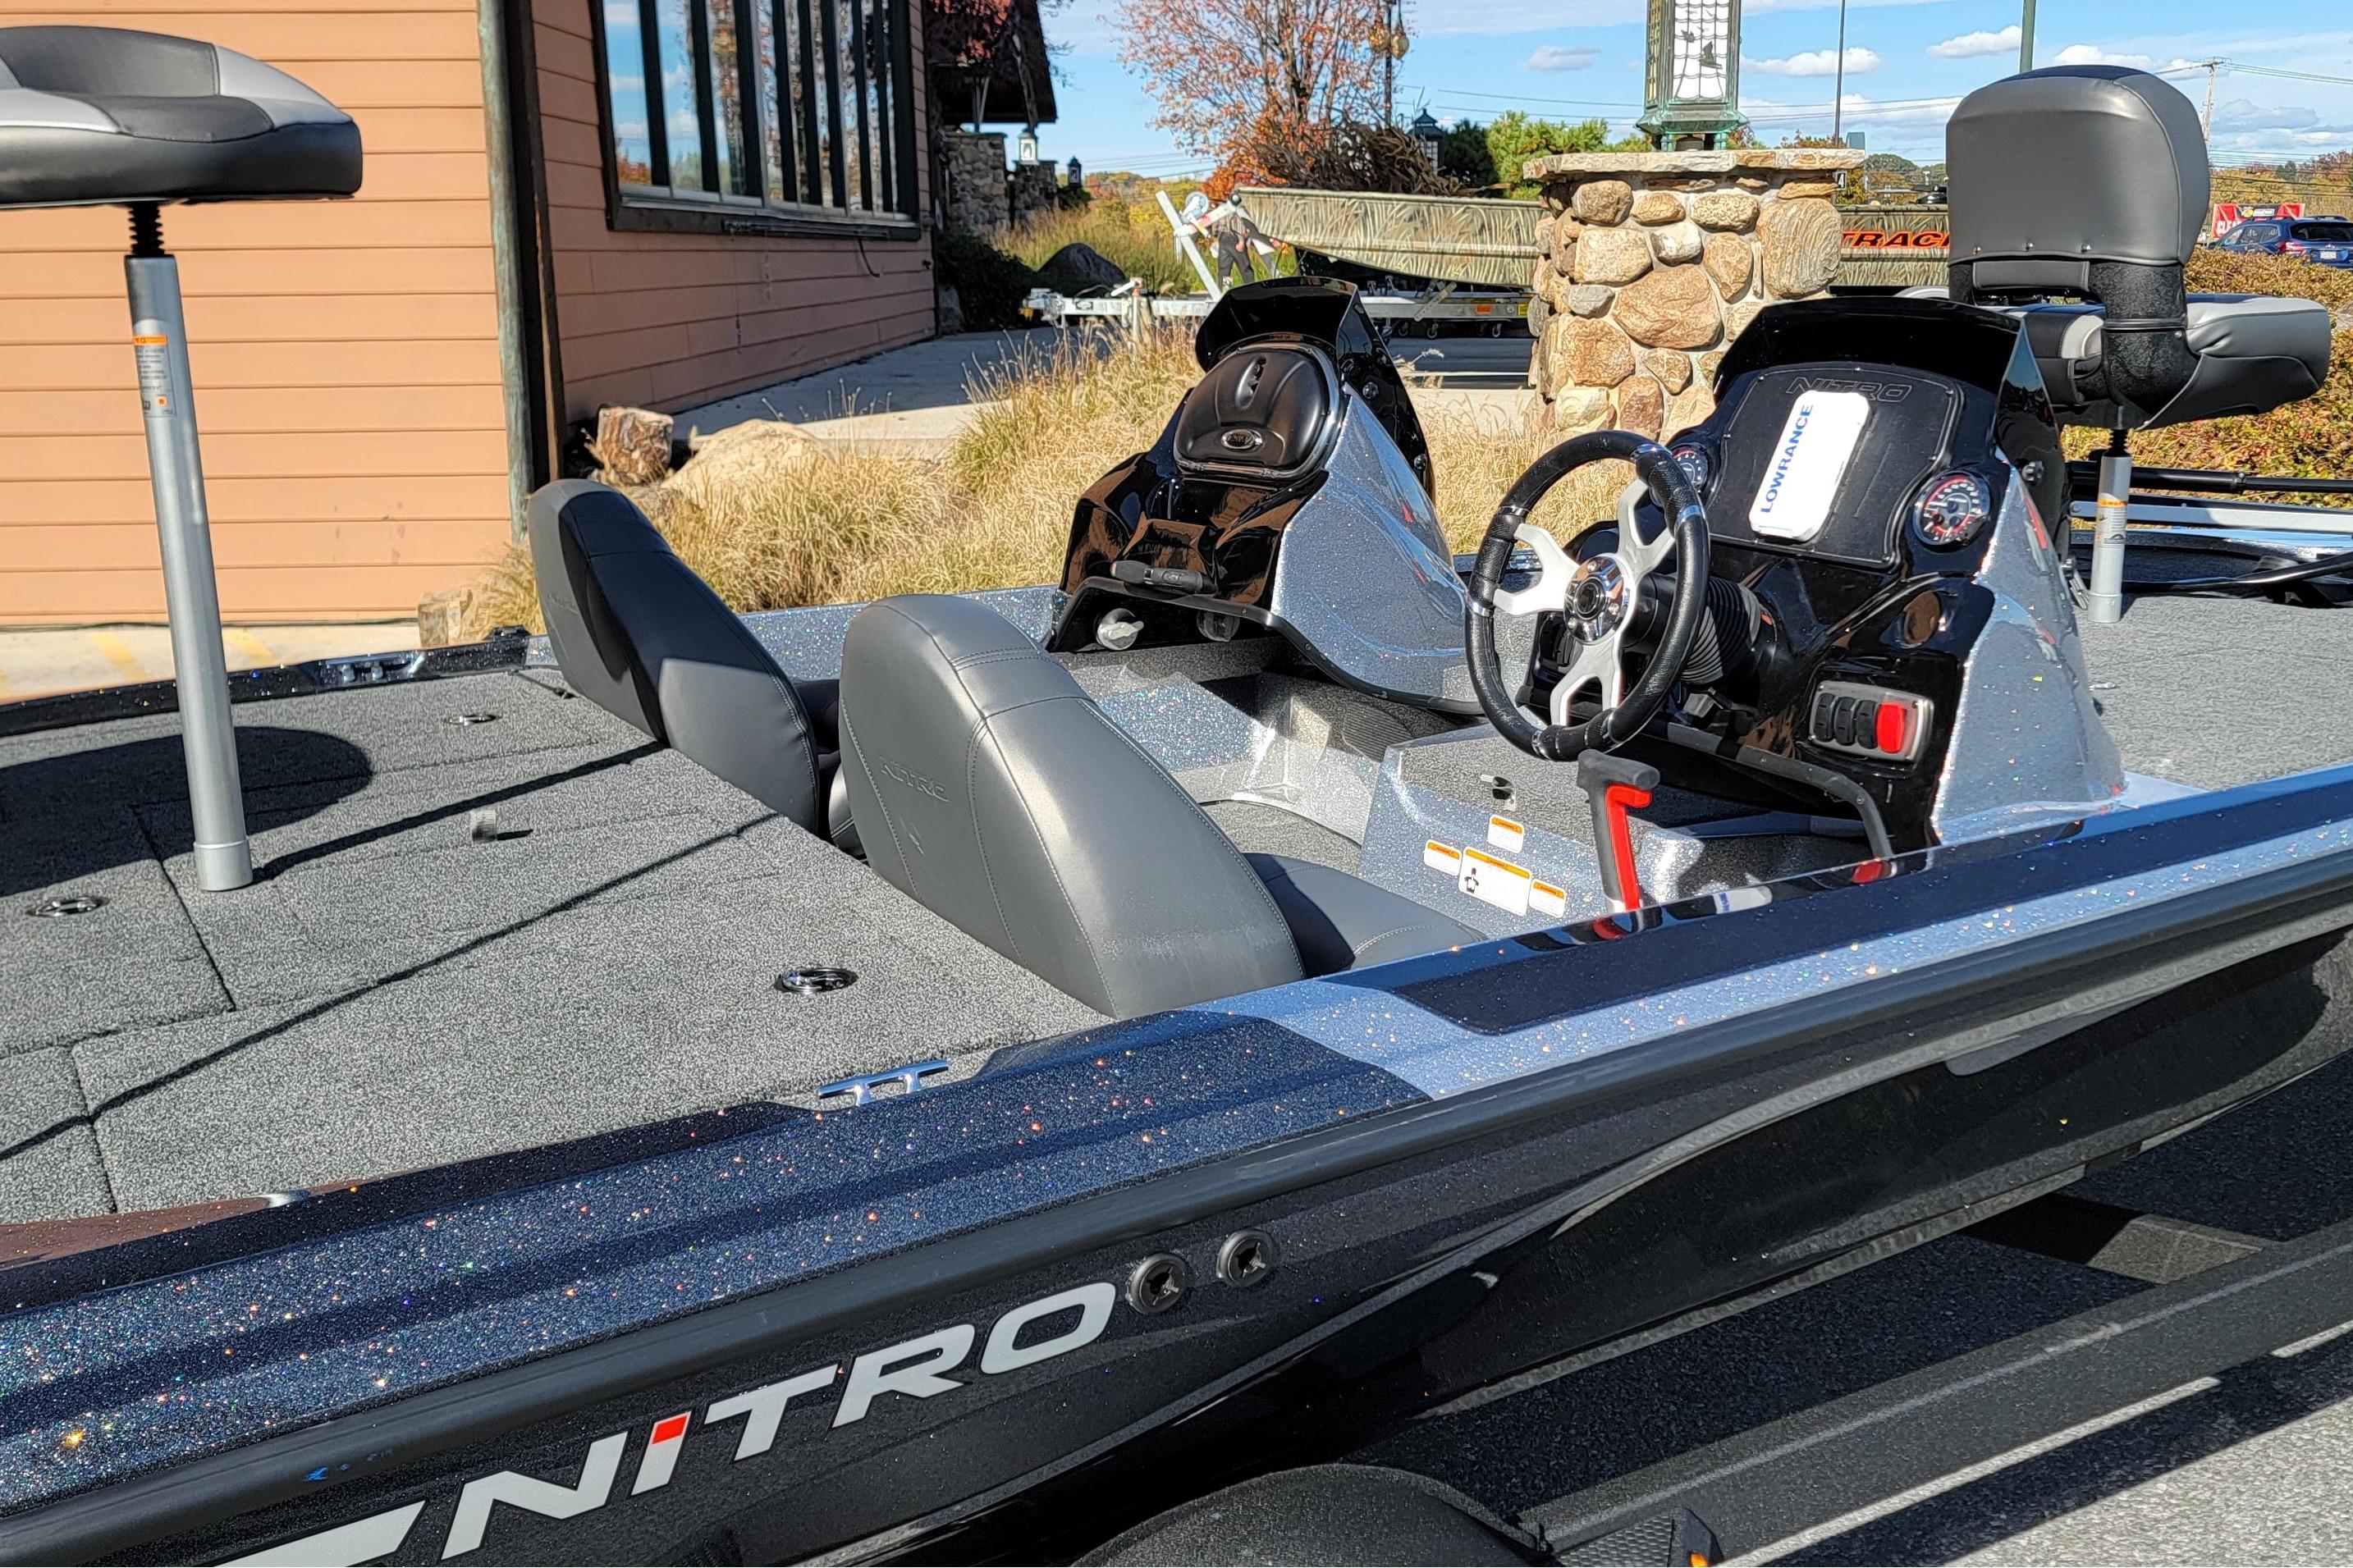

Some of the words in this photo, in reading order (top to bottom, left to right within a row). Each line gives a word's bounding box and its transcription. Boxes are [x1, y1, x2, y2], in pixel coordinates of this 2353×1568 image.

[1841, 230, 1951, 249] TRAC
[1785, 377, 1912, 403] NITRO
[1760, 405, 1814, 514] LOWRANCE
[441, 1282, 1118, 1561] NITRO
